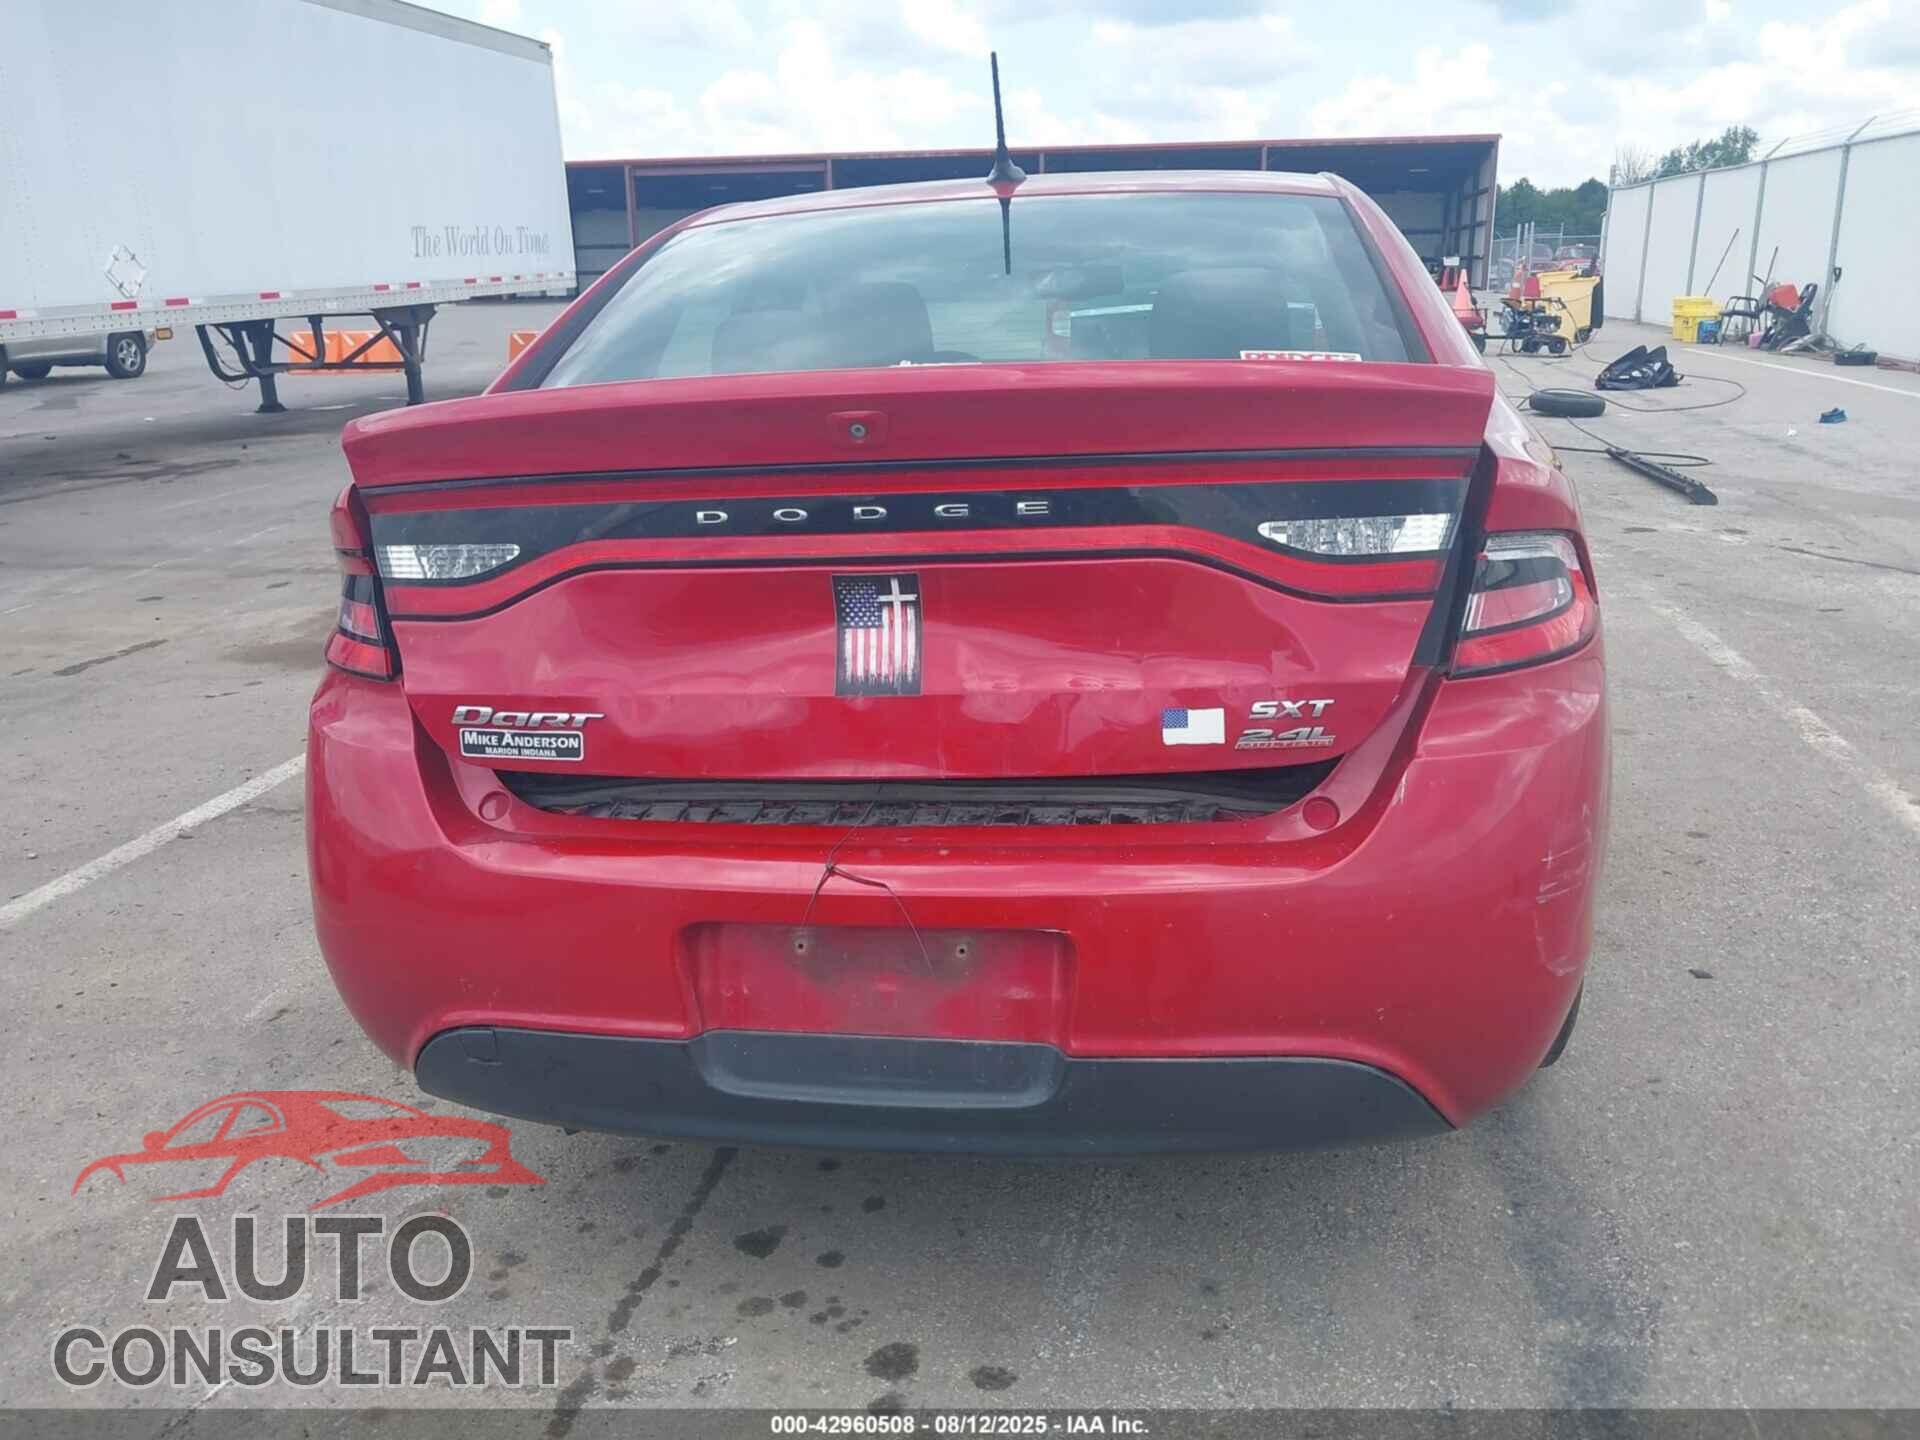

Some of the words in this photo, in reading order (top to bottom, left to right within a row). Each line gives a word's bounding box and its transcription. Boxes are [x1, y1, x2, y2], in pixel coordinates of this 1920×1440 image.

[411, 225, 441, 258] The
[445, 225, 489, 256] World
[493, 225, 513, 255] On
[515, 226, 550, 254] Time
[696, 501, 1049, 525] DODGE
[1249, 699, 1335, 719] SXT
[1239, 726, 1336, 743] 2.4L
